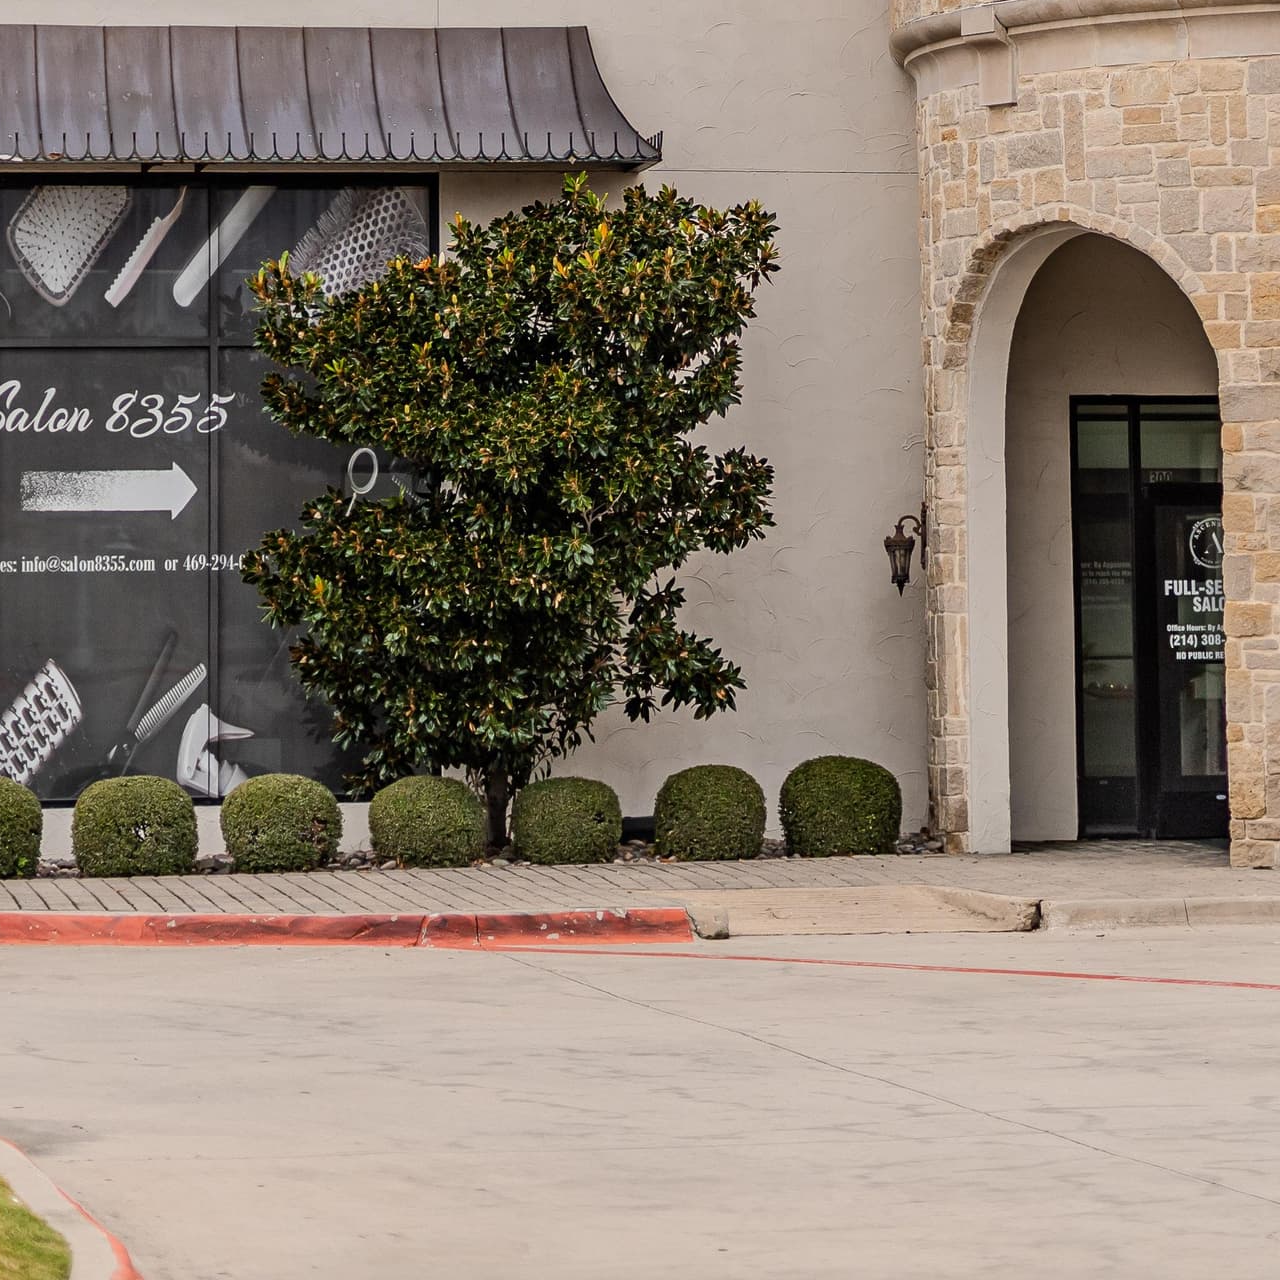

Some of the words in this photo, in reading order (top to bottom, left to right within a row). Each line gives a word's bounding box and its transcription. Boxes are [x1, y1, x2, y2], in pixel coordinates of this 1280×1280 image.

[105, 390, 236, 438] 8355
[22, 555, 155, 573] info@salon8355.com
[165, 558, 178, 571] or
[1169, 634, 1198, 648] (214)
[1176, 651, 1187, 660] NO
[1188, 651, 1214, 660] PUBLIC
